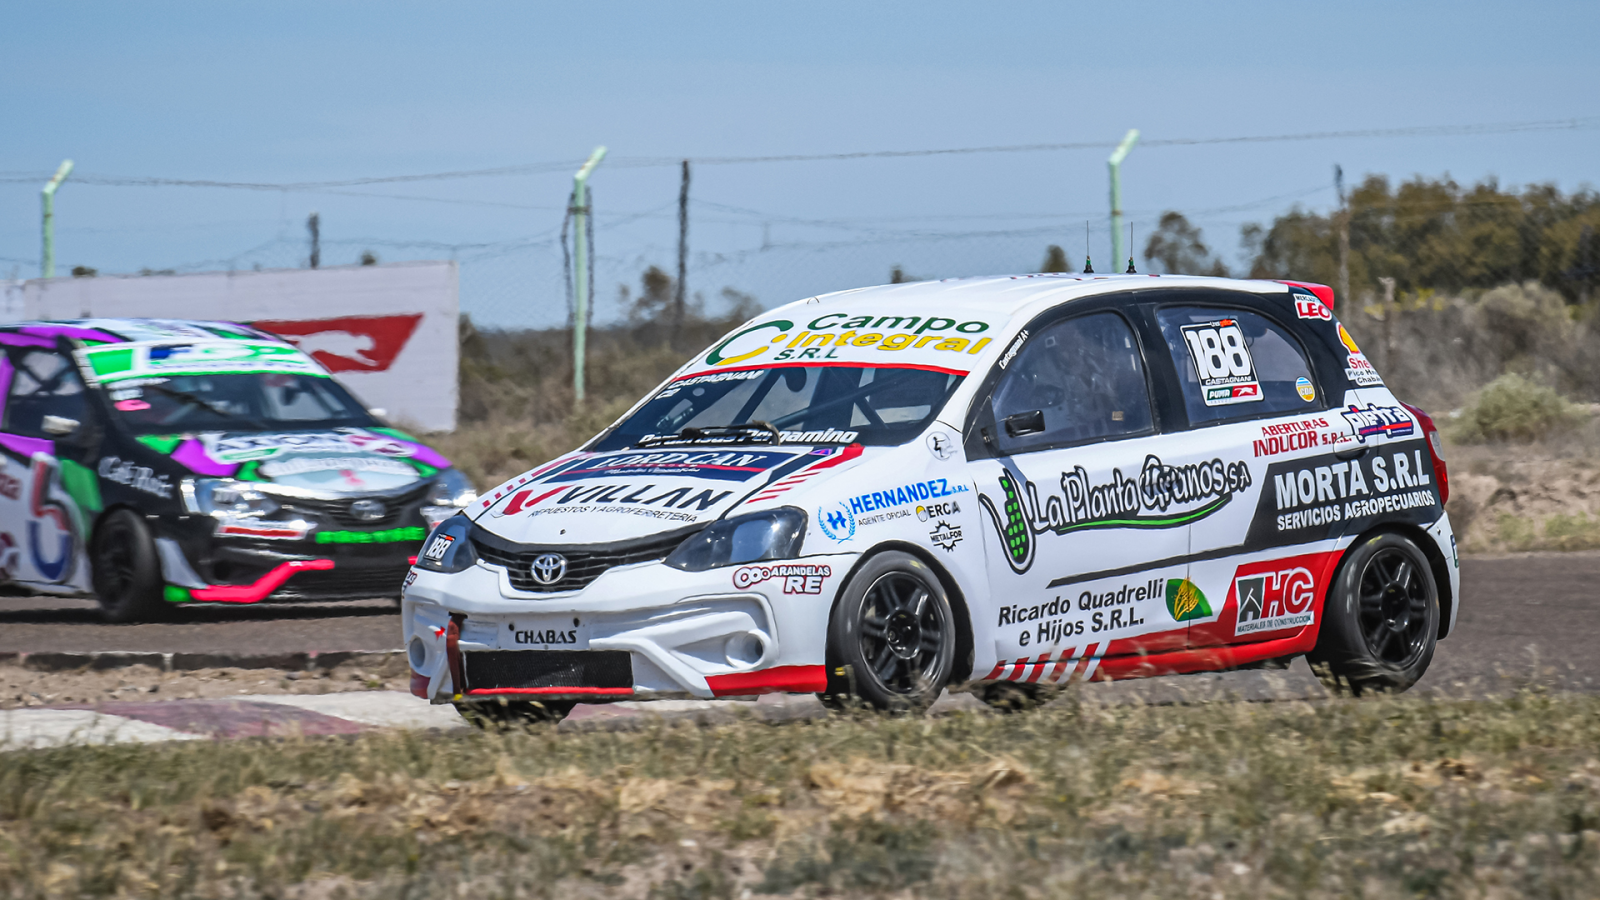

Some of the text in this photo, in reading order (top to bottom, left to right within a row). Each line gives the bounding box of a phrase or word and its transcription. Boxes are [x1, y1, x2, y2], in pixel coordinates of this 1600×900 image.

[1297, 302, 1330, 319] LEO
[808, 313, 990, 335] Campo
[785, 330, 993, 355] Integral
[1185, 326, 1251, 380] 188
[773, 347, 839, 361] S.R.L
[1205, 376, 1251, 386] CASTAGNANI
[1261, 417, 1329, 437] ABERTURAS
[1253, 431, 1319, 457] INDUCOR
[1274, 450, 1430, 510] MORTA S.R.L
[557, 484, 735, 511] VILLAN
[849, 478, 952, 514] HERNANDEZ
[527, 506, 590, 518] REPUESTOS
[858, 509, 912, 526] AGENTE OFICIAL
[1277, 490, 1435, 531] SERVICIOS AGROPECUARIOS
[930, 530, 962, 542] METALFOR
[425, 537, 452, 559] 188
[770, 564, 831, 577] ARANDELAS
[784, 576, 823, 594] RE
[998, 578, 1163, 627] Ricardo Quadrelli
[1019, 607, 1145, 647] e Hijos S.R.L.
[1237, 619, 1265, 633] MATERIALES
[515, 630, 576, 644] CHABAS
